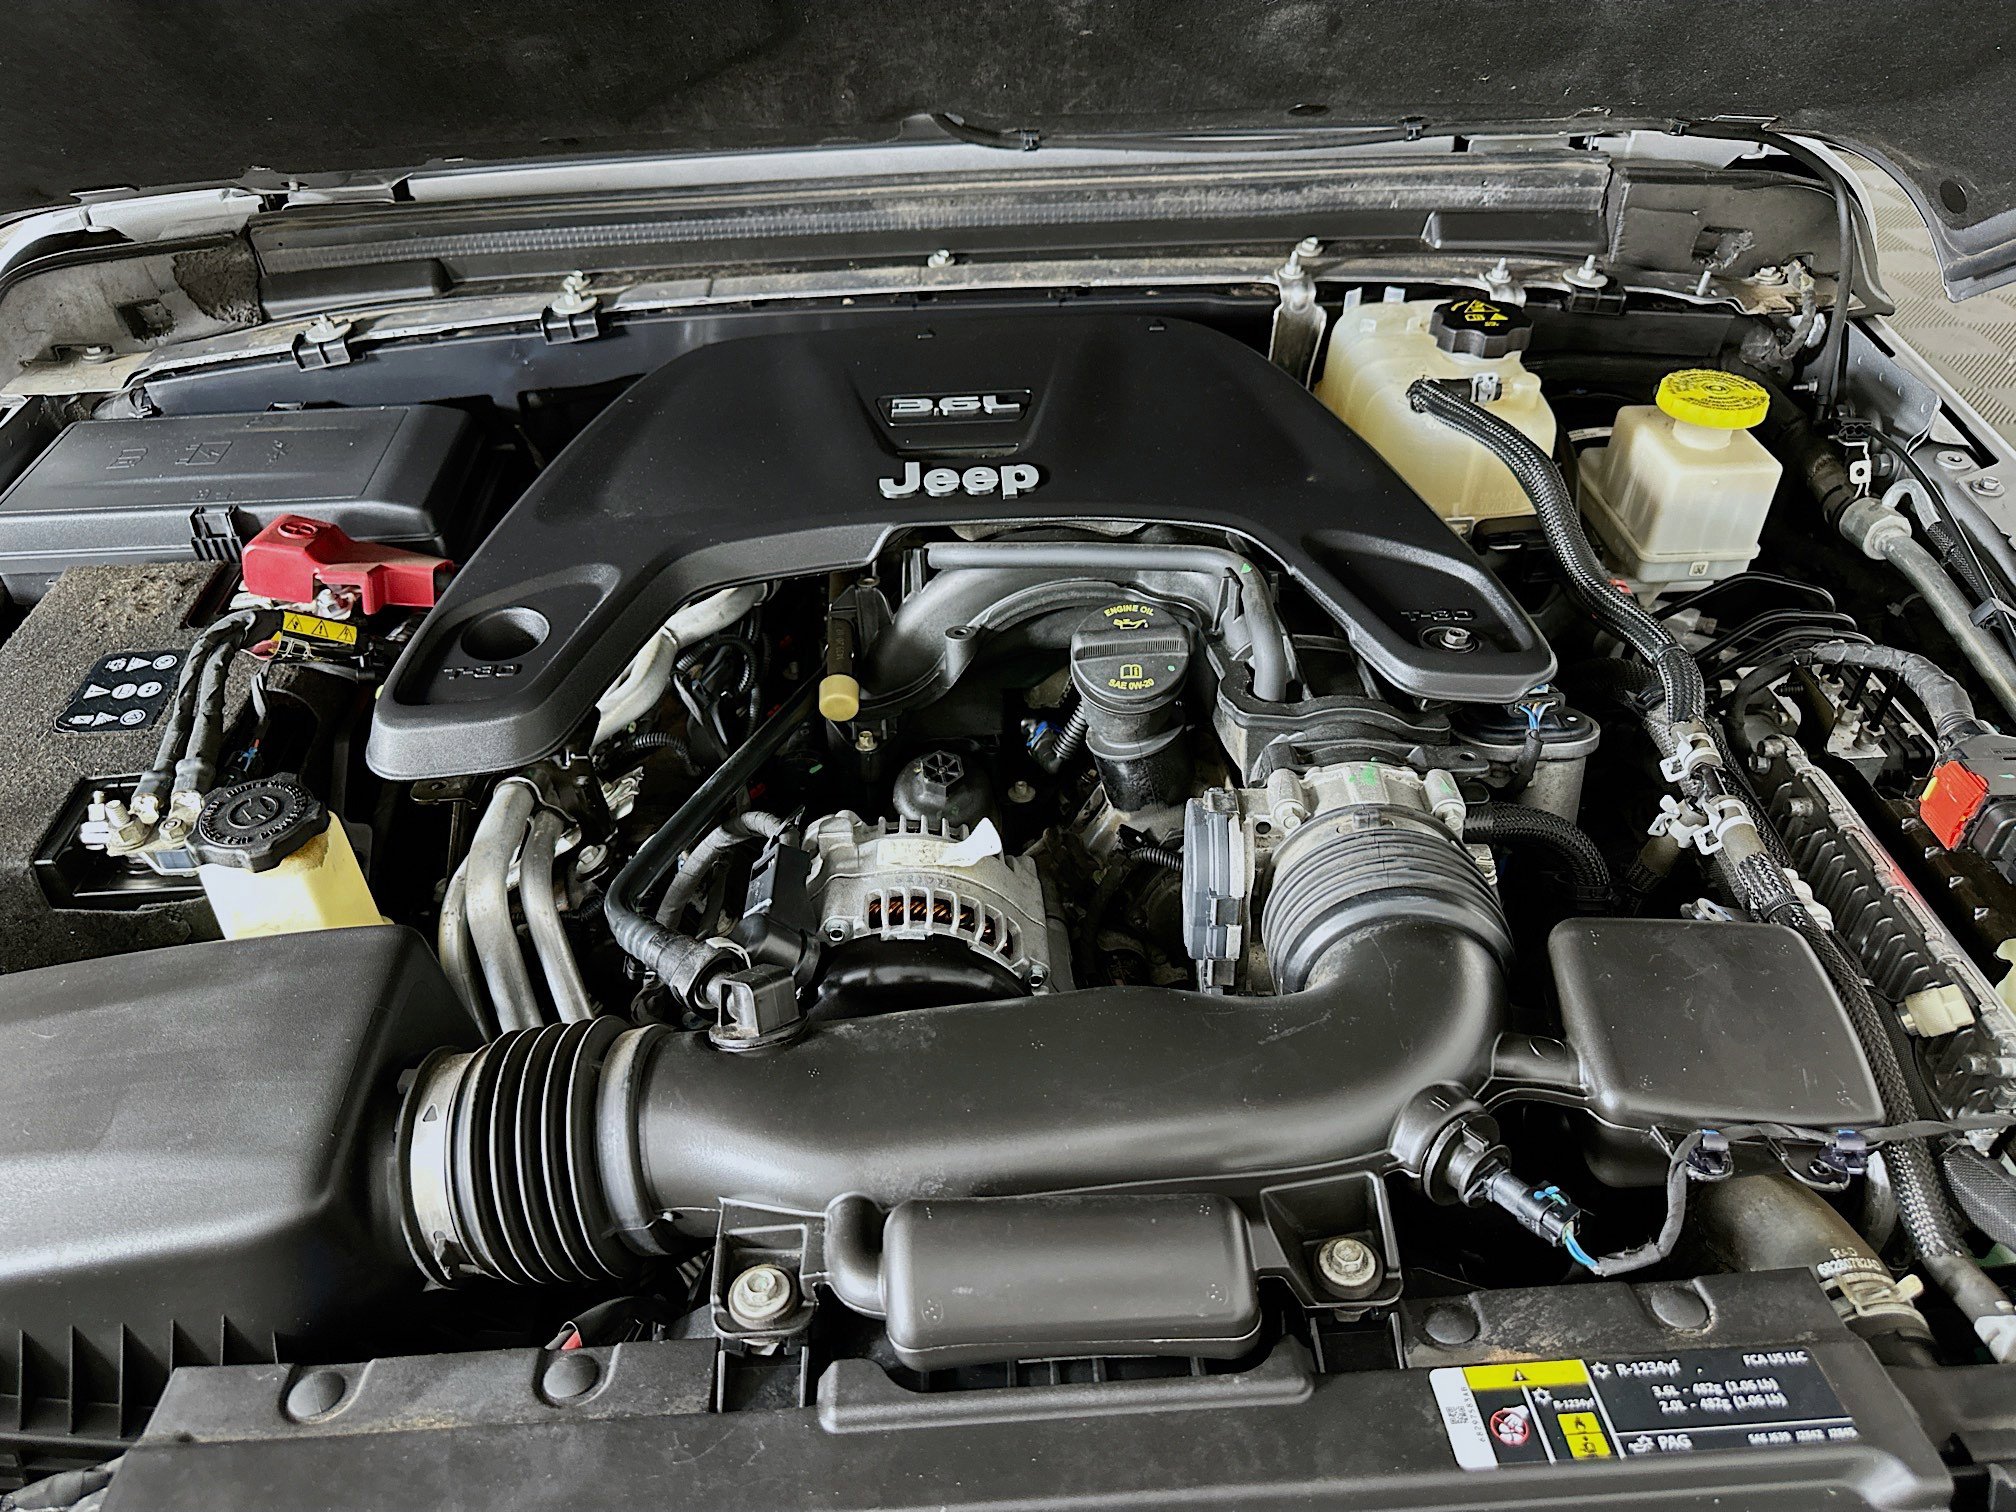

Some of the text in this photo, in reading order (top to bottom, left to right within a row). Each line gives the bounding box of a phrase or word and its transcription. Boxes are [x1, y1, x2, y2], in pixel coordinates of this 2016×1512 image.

[891, 395, 1020, 418] 3.6L
[879, 461, 1040, 500] Jeep
[1103, 604, 1155, 617] ENGINE OIL
[1108, 678, 1155, 690] SAE 0W-20
[1742, 1350, 1809, 1368] FCA US LLC
[1614, 1359, 1681, 1378] R-1234yf
[1651, 1384, 1681, 1400] 3.6L
[1658, 1400, 1688, 1416] 2.0L
[1657, 1434, 1693, 1452] PAG
